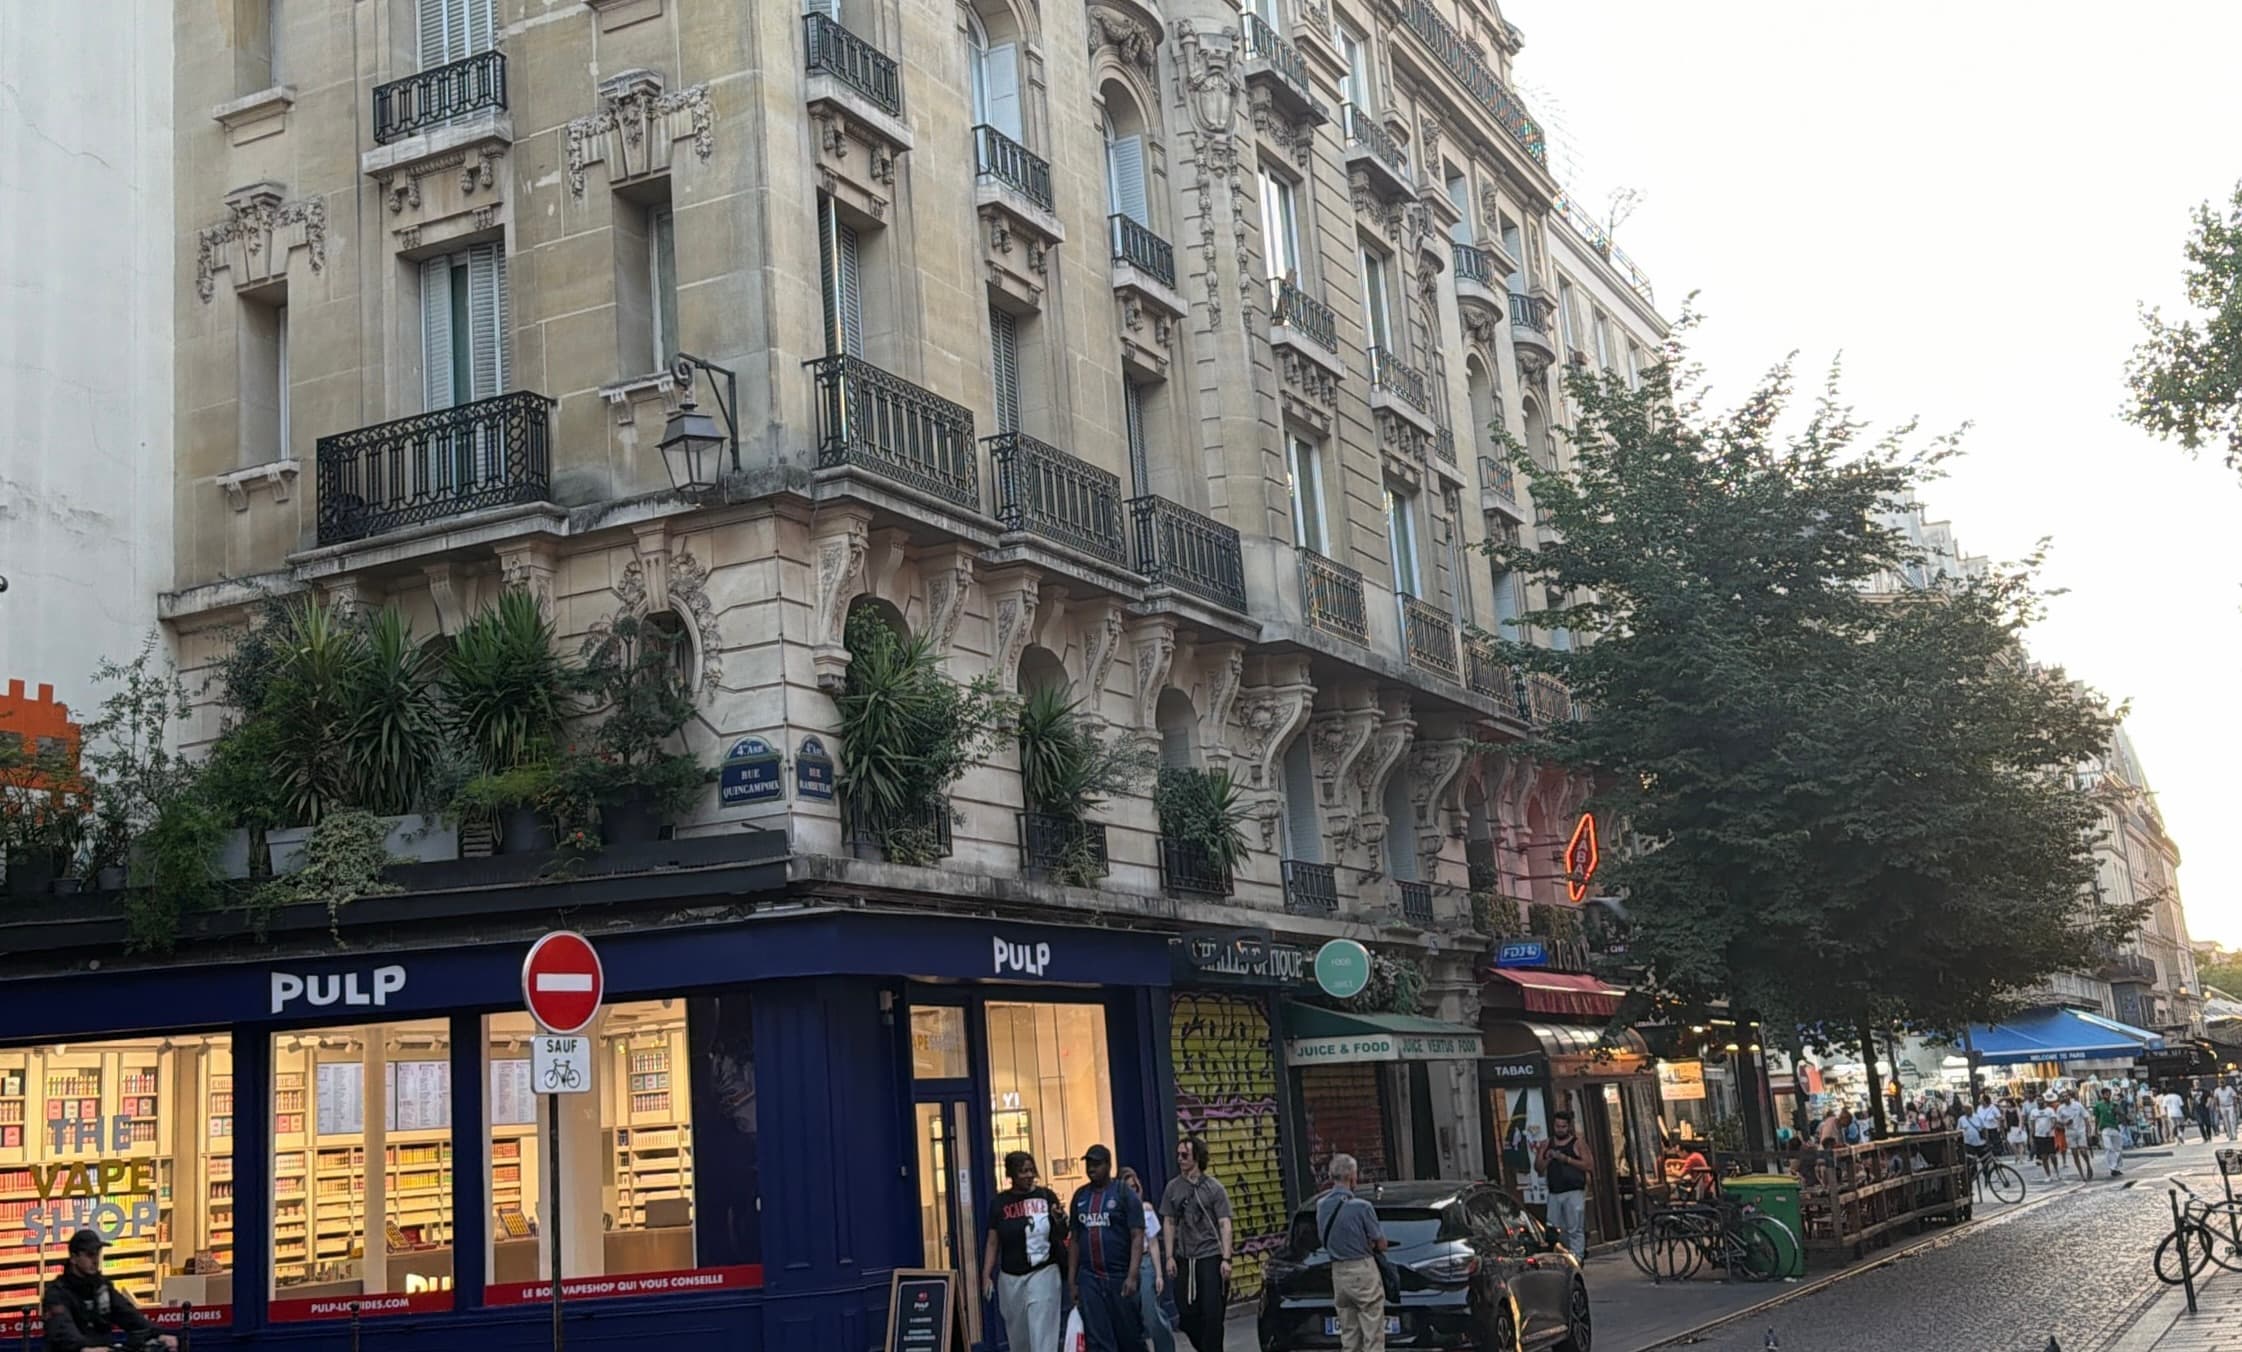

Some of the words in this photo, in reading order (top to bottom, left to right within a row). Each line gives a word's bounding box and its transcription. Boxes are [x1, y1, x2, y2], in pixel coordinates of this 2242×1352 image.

[741, 768, 760, 779] RUE
[723, 779, 779, 798] QUINCAMPOIX
[1575, 827, 1589, 886] TABA
[993, 936, 1050, 976] PULP
[1503, 947, 1526, 958] FDJ
[271, 965, 406, 1014] PULP
[546, 1039, 577, 1053] SAUF
[1298, 1044, 1335, 1057] JUICE
[1340, 1043, 1349, 1055] &
[1354, 1040, 1390, 1053] FOOD
[1403, 1039, 1423, 1053] JUICE
[1458, 1039, 1476, 1053] FOOD
[1495, 1065, 1534, 1076] TABAC
[48, 1115, 131, 1154] THE
[30, 1157, 151, 1198] VAPE
[1003, 1201, 1046, 1219] SCARFACE
[22, 1202, 157, 1245] SHOP
[1079, 1212, 1111, 1227] QATAR
[523, 1289, 533, 1298] LE
[535, 1287, 553, 1297] BO
[562, 1283, 615, 1295] VAPESHOP
[618, 1280, 637, 1291] QUI
[640, 1278, 668, 1289] VOUS
[671, 1274, 723, 1286] CONSEILLE
[311, 1298, 409, 1313] PULP-LIIDES.COM
[157, 1311, 221, 1322] ACCESOIRES
